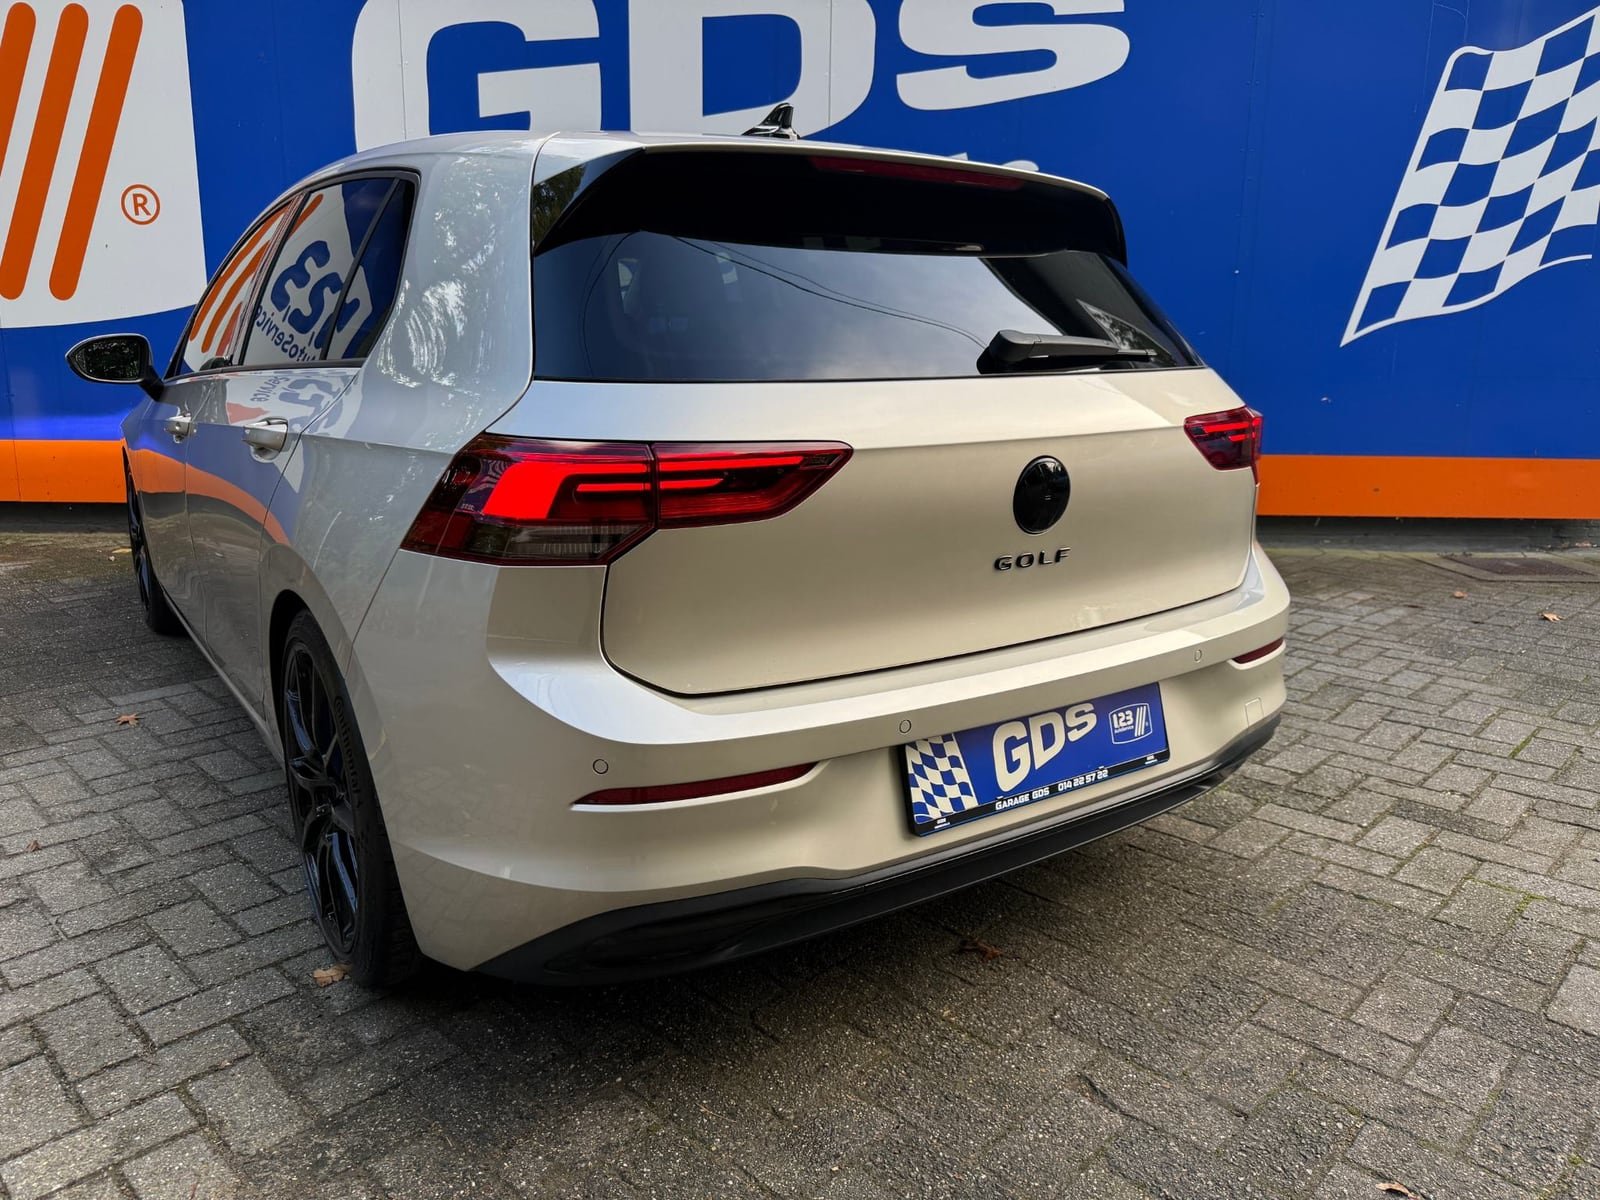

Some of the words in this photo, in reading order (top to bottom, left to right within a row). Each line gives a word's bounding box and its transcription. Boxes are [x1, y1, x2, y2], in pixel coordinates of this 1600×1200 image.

[352, 0, 1130, 142] GDS
[994, 547, 1071, 570] GOLF
[1112, 710, 1134, 729] 123
[992, 703, 1098, 792] GDS
[995, 793, 1030, 810] GARAGE
[1032, 787, 1050, 800] GDS
[1057, 781, 1072, 791] 014
[1073, 777, 1084, 787] 22
[1085, 773, 1096, 783] 57
[1097, 769, 1109, 779] 22
